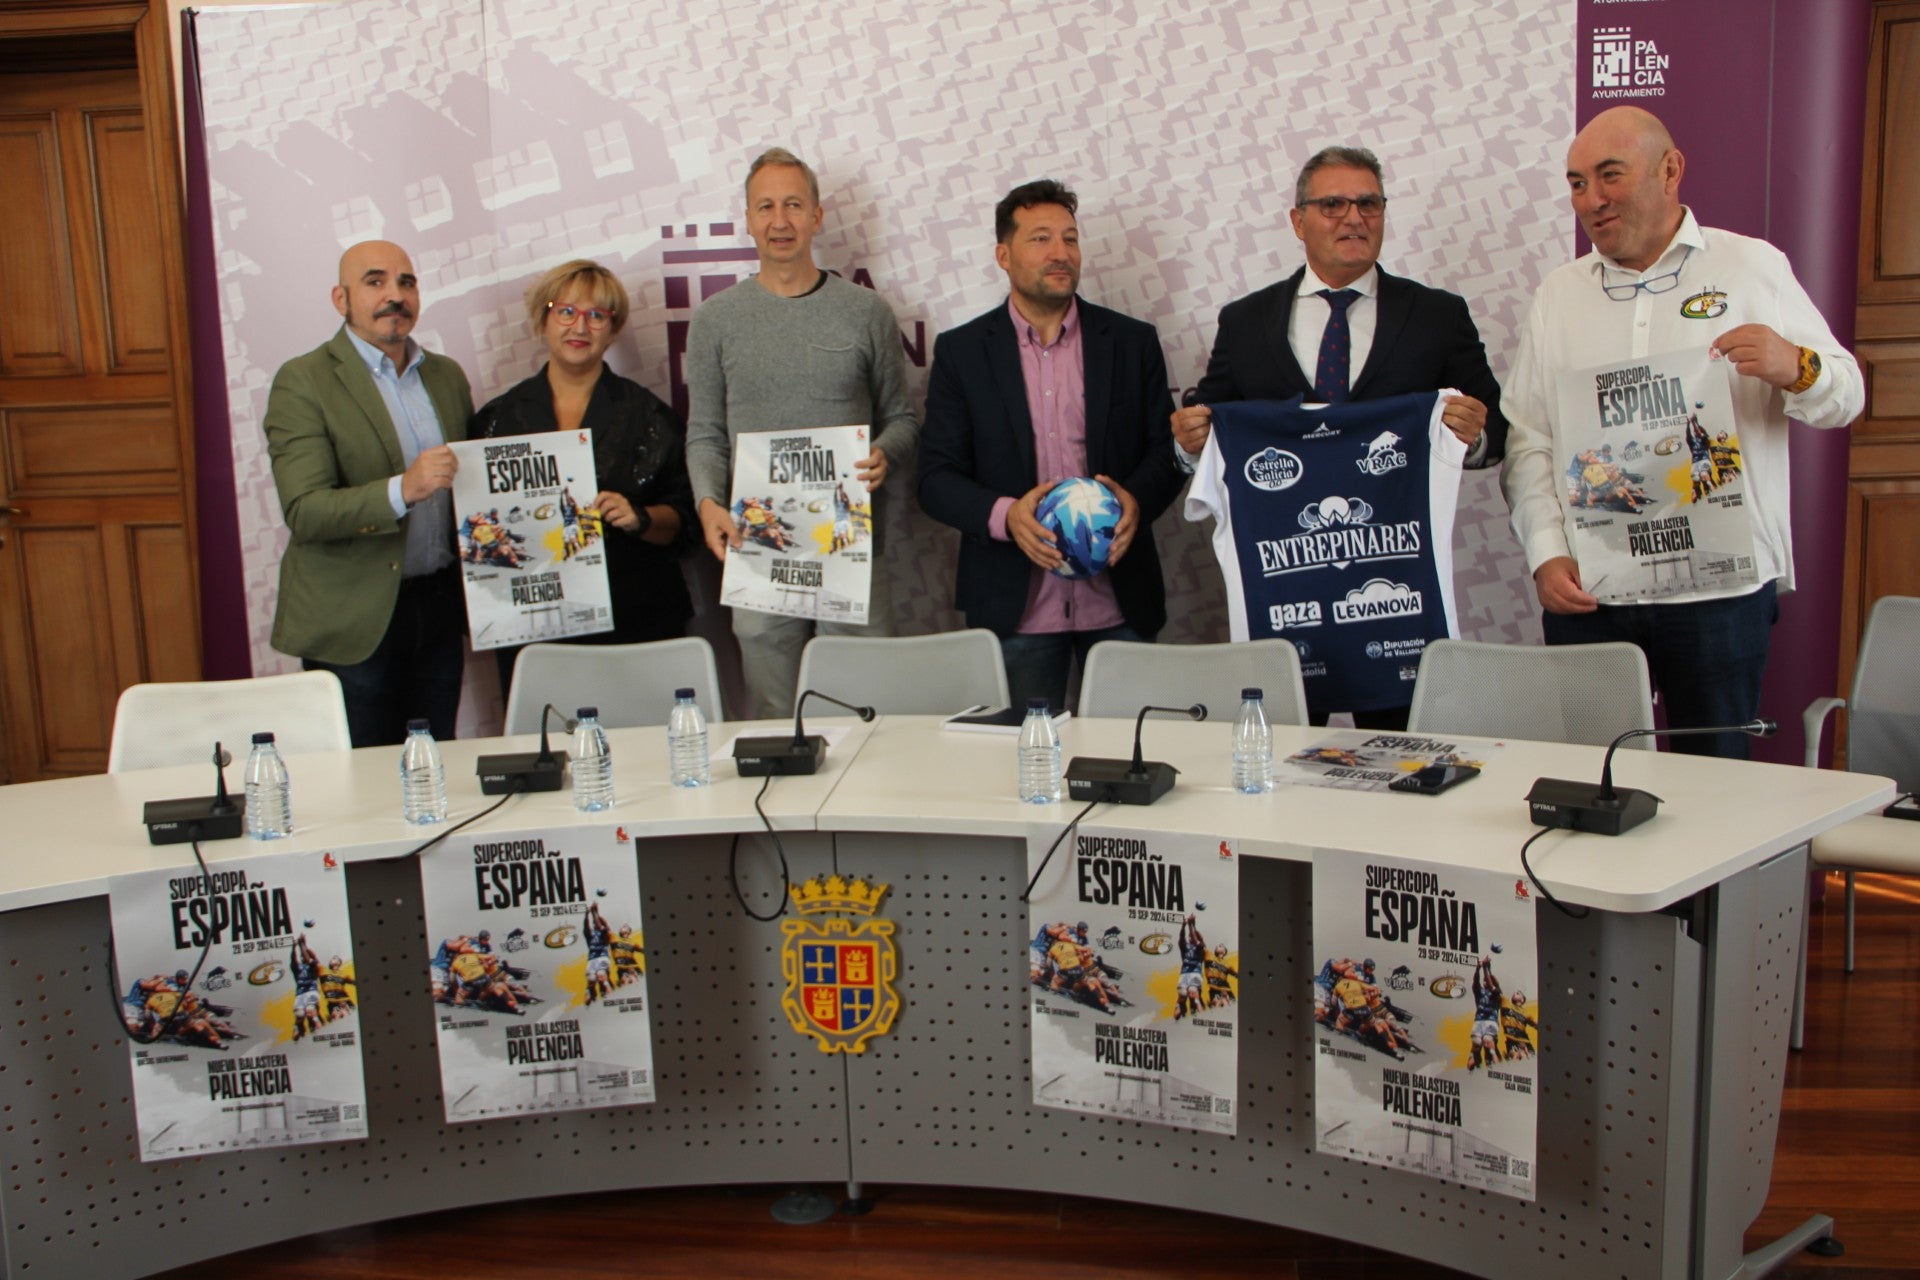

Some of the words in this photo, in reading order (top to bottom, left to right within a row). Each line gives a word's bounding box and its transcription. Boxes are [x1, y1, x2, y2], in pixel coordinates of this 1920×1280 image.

[1634, 40, 1658, 54] PA
[1634, 55, 1669, 70] LEN
[1634, 70, 1664, 85] CIA
[1592, 87, 1665, 99] AYUNTAMIENTO
[1596, 365, 1652, 391] SUPERCOPA
[1597, 372, 1688, 429] ESPAÑA
[770, 436, 812, 452] SUPERCOPA
[1302, 429, 1341, 440] MERCURY
[484, 442, 533, 461] SUPERCOPA
[1356, 452, 1407, 475] VRAC
[486, 450, 561, 494] ESPAÑA
[769, 445, 836, 484] ESPAÑA
[1252, 458, 1294, 472] Estrella
[1255, 468, 1293, 482] Galicia
[1627, 521, 1650, 535] NUEVA
[1650, 515, 1689, 532] BALASTERA
[1256, 521, 1421, 573] ENTREPINARES
[1629, 528, 1694, 557] PALENCIA
[770, 568, 823, 587] PALENCIA
[512, 581, 564, 606] PALENCIA
[1269, 601, 1322, 631] gaza
[1335, 597, 1419, 620] LEVANOVA
[1383, 638, 1426, 650] DIPUTACIÓN
[1532, 803, 1556, 812] OPTIMUS
[473, 839, 545, 864] SUPERCOPA
[1077, 835, 1147, 860] SUPERCOPA
[475, 850, 586, 911] ESPAÑA
[1077, 854, 1185, 912] ESPAÑA
[1366, 864, 1438, 896] SUPERCOPA
[171, 881, 292, 950] ESPAÑA
[1137, 910, 1148, 921] SEP
[1150, 911, 1166, 922] 2024
[1366, 889, 1479, 953] ESPAÑA
[1418, 948, 1427, 959] 29
[1428, 950, 1440, 961] SEP
[1442, 952, 1459, 964] 2024
[506, 1023, 533, 1039] NUEVA
[535, 1019, 581, 1037] BALASTERA
[1095, 1023, 1120, 1039] NUEVA
[1123, 1025, 1167, 1045] BALASTERA
[508, 1034, 584, 1065] PALENCIA
[1095, 1037, 1169, 1072] PALENCIA
[207, 1058, 236, 1074] NUEVA
[238, 1053, 288, 1071] BALASTERA
[209, 1068, 292, 1101] PALENCIA
[1383, 1068, 1409, 1086] NUEVA
[1412, 1073, 1460, 1097] BALASTERA
[1383, 1084, 1462, 1127] PALENCIA
